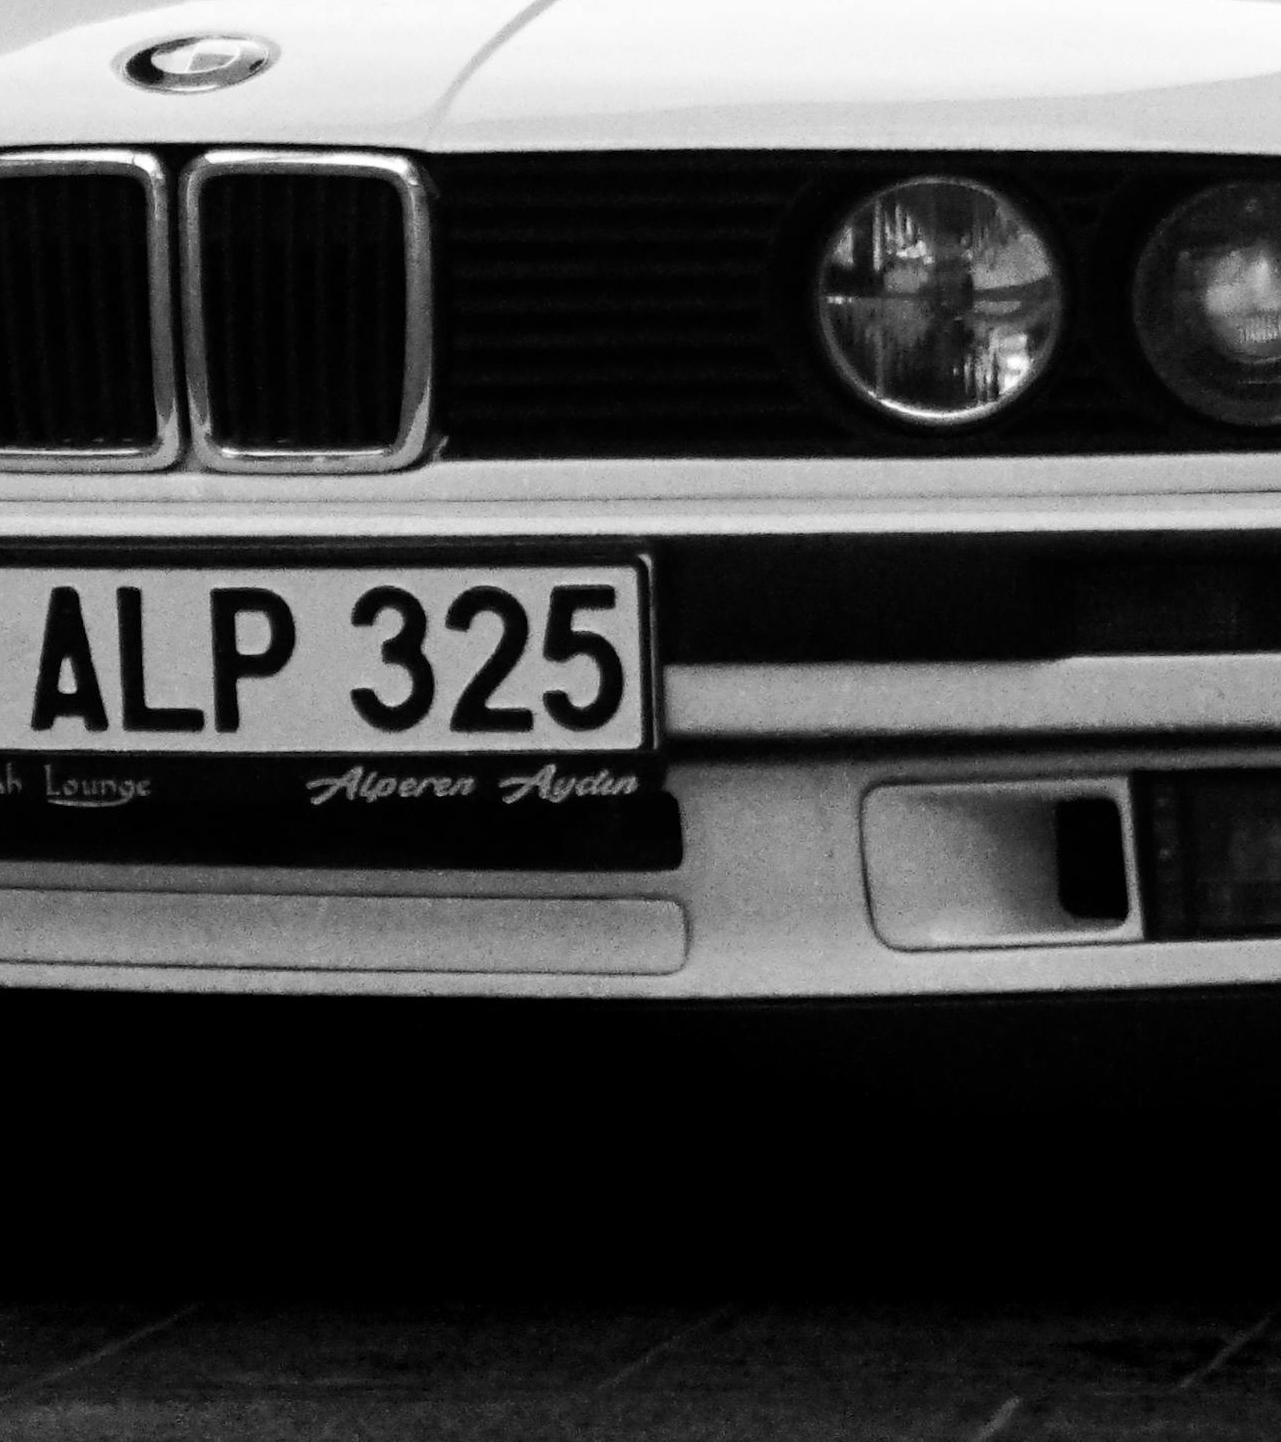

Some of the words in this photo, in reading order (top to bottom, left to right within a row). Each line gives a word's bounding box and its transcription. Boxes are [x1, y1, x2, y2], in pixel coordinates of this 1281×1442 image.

[30, 586, 296, 732] ALP
[350, 585, 626, 732] 325
[44, 764, 152, 808] Lounge
[305, 764, 477, 806] Alperen
